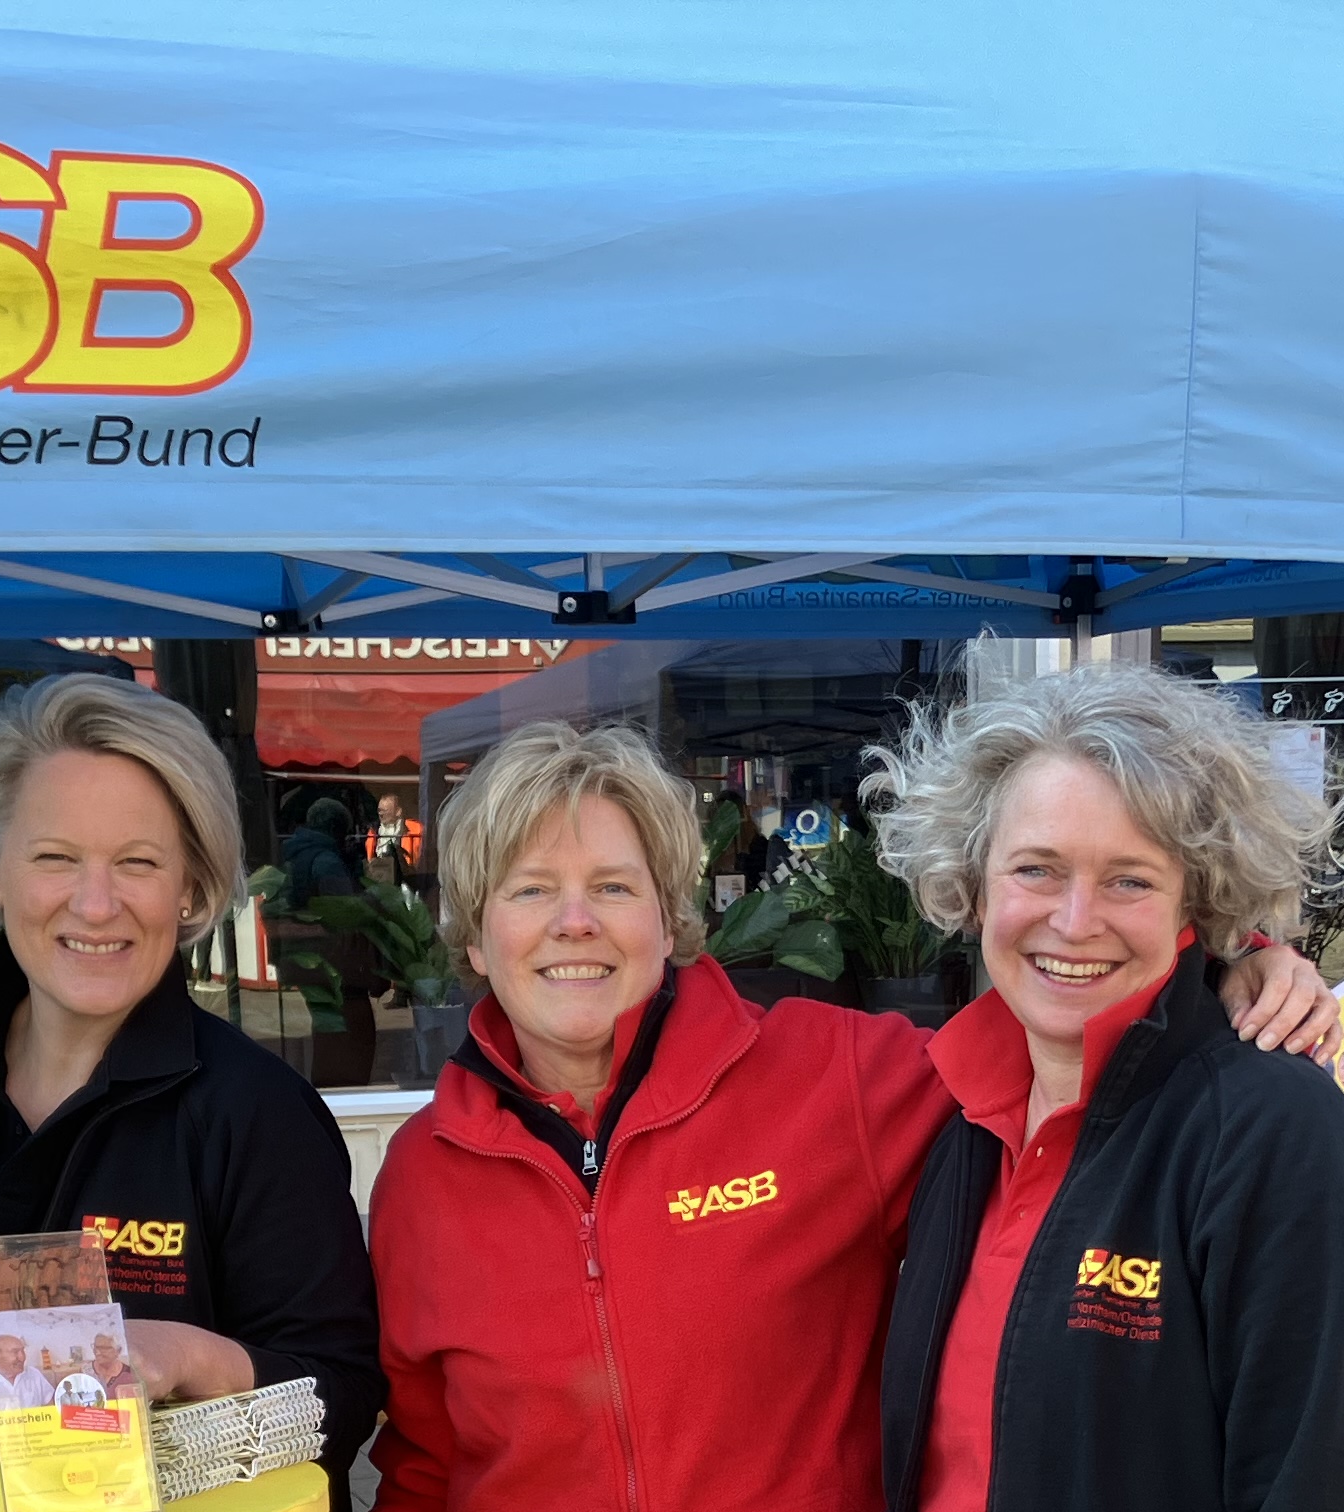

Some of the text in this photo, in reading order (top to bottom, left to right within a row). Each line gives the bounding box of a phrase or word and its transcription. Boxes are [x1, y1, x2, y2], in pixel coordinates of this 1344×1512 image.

[699, 1170, 778, 1217] ASB
[106, 1219, 186, 1256] ASB
[1087, 1253, 1162, 1298] ASB
